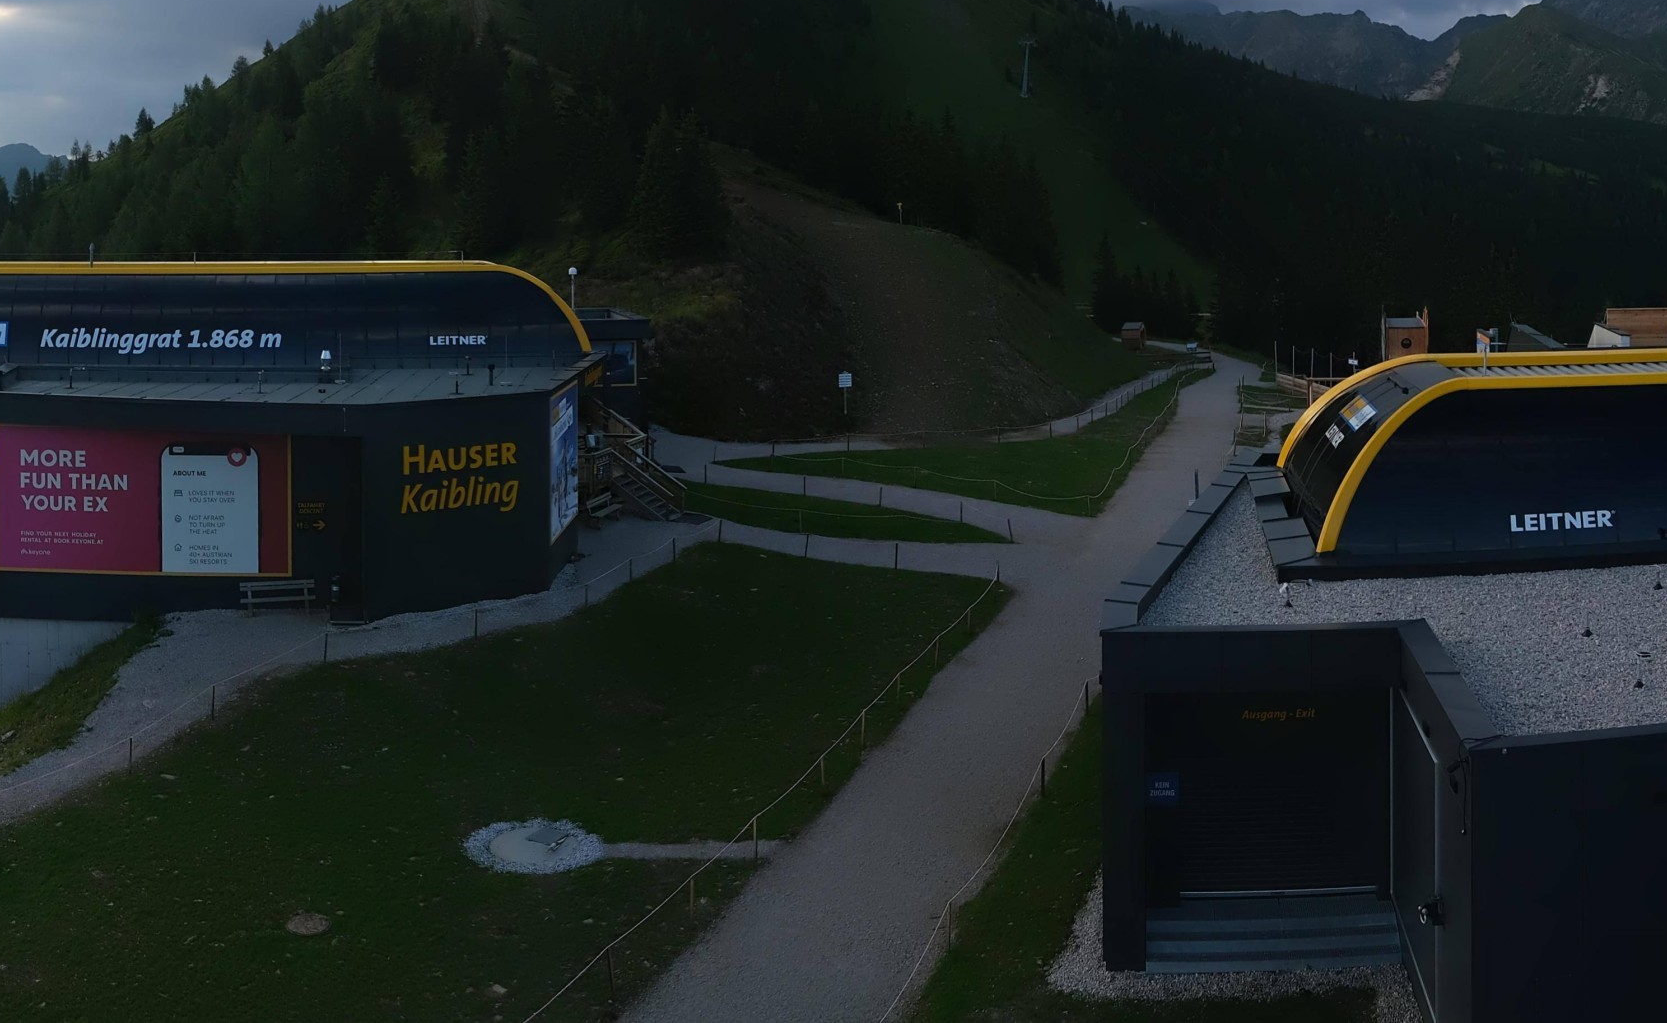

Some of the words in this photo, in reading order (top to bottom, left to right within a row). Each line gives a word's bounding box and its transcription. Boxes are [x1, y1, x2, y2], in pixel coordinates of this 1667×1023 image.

[40, 328, 182, 354] Kaiblinggrat
[187, 329, 254, 349] 1.868
[259, 333, 282, 349] m
[430, 335, 486, 345] LEITNER
[20, 449, 87, 467] MORE
[402, 442, 518, 476] HAUSER
[20, 472, 61, 489] FUN
[68, 473, 128, 491] THAN
[20, 494, 77, 512] YOUR
[83, 496, 109, 513] EX
[400, 476, 519, 514] Kaibling
[1510, 510, 1614, 532] LEITNER
[1242, 709, 1287, 721] Ausgang
[1296, 708, 1316, 718] Exit
[1154, 781, 1169, 789] KEIN
